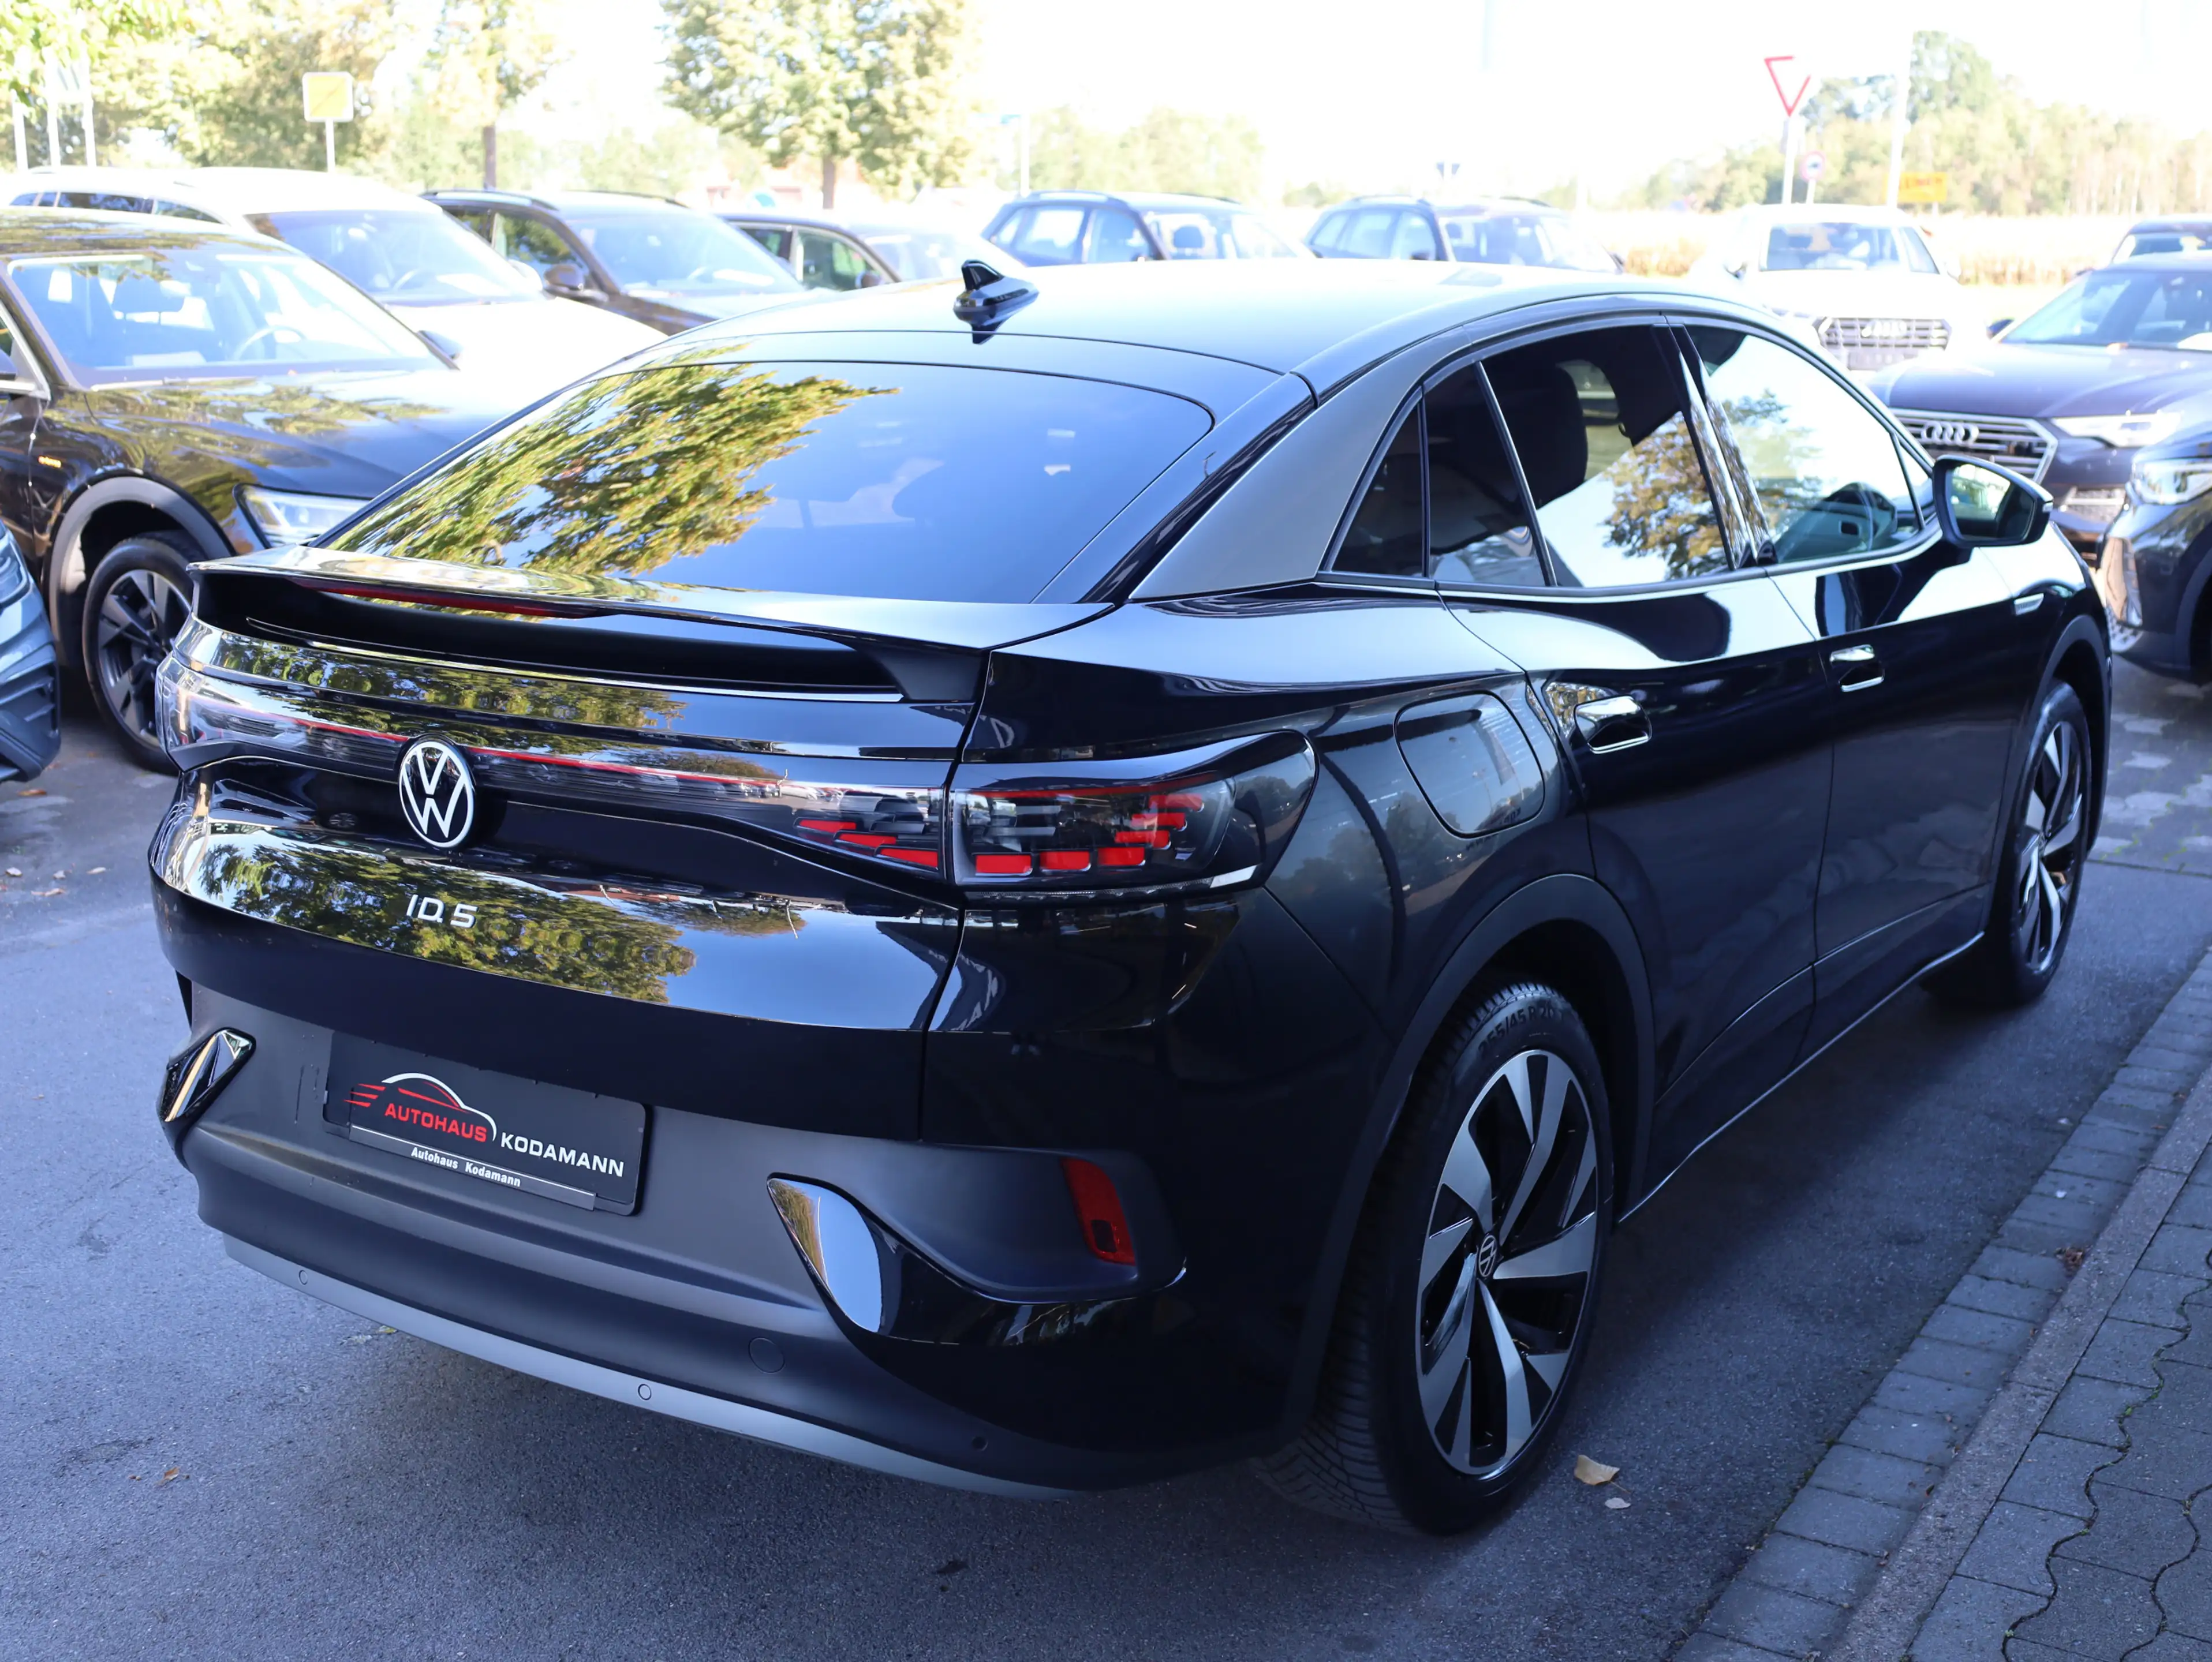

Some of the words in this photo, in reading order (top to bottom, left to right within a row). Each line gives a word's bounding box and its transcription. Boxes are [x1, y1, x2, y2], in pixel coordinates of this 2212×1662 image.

[384, 1103, 487, 1143] AUTOHAUS
[500, 1132, 625, 1178] KODAMANN
[410, 1147, 459, 1170] Autohaus
[465, 1162, 521, 1187] Kodamann
